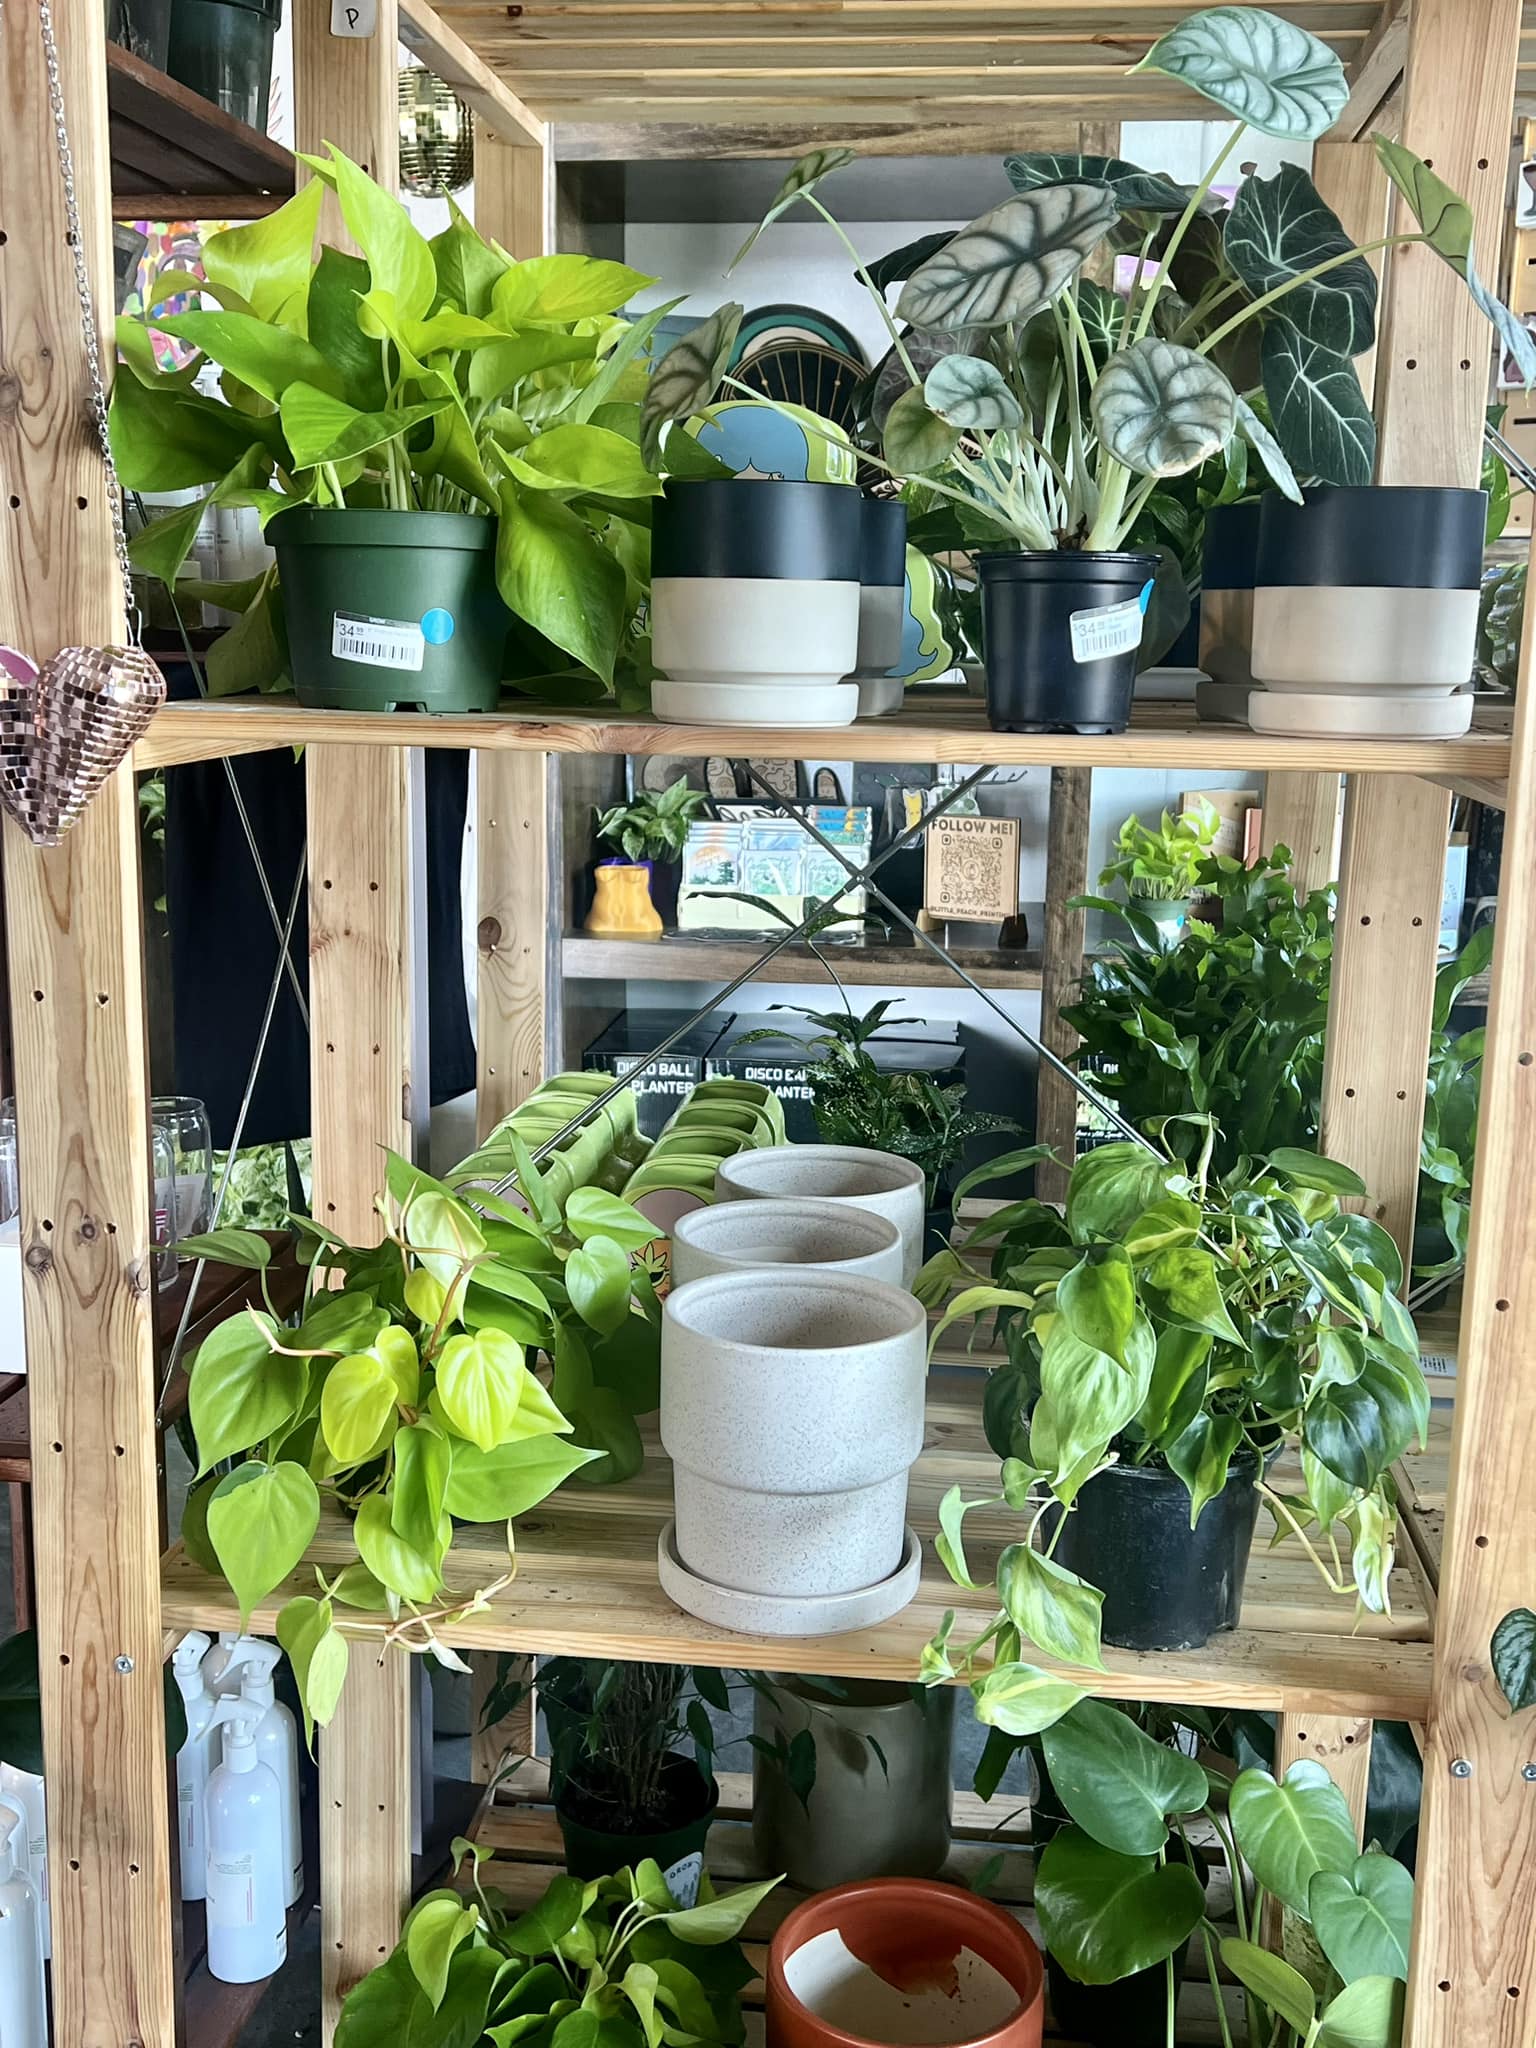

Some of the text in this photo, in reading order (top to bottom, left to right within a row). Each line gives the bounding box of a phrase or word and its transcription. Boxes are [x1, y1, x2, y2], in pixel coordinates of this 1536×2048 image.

[345, 8, 359, 29] P
[932, 819, 986, 834] FOLLOW
[658, 1062, 694, 1077] BALL
[745, 1066, 783, 1081] DISCO
